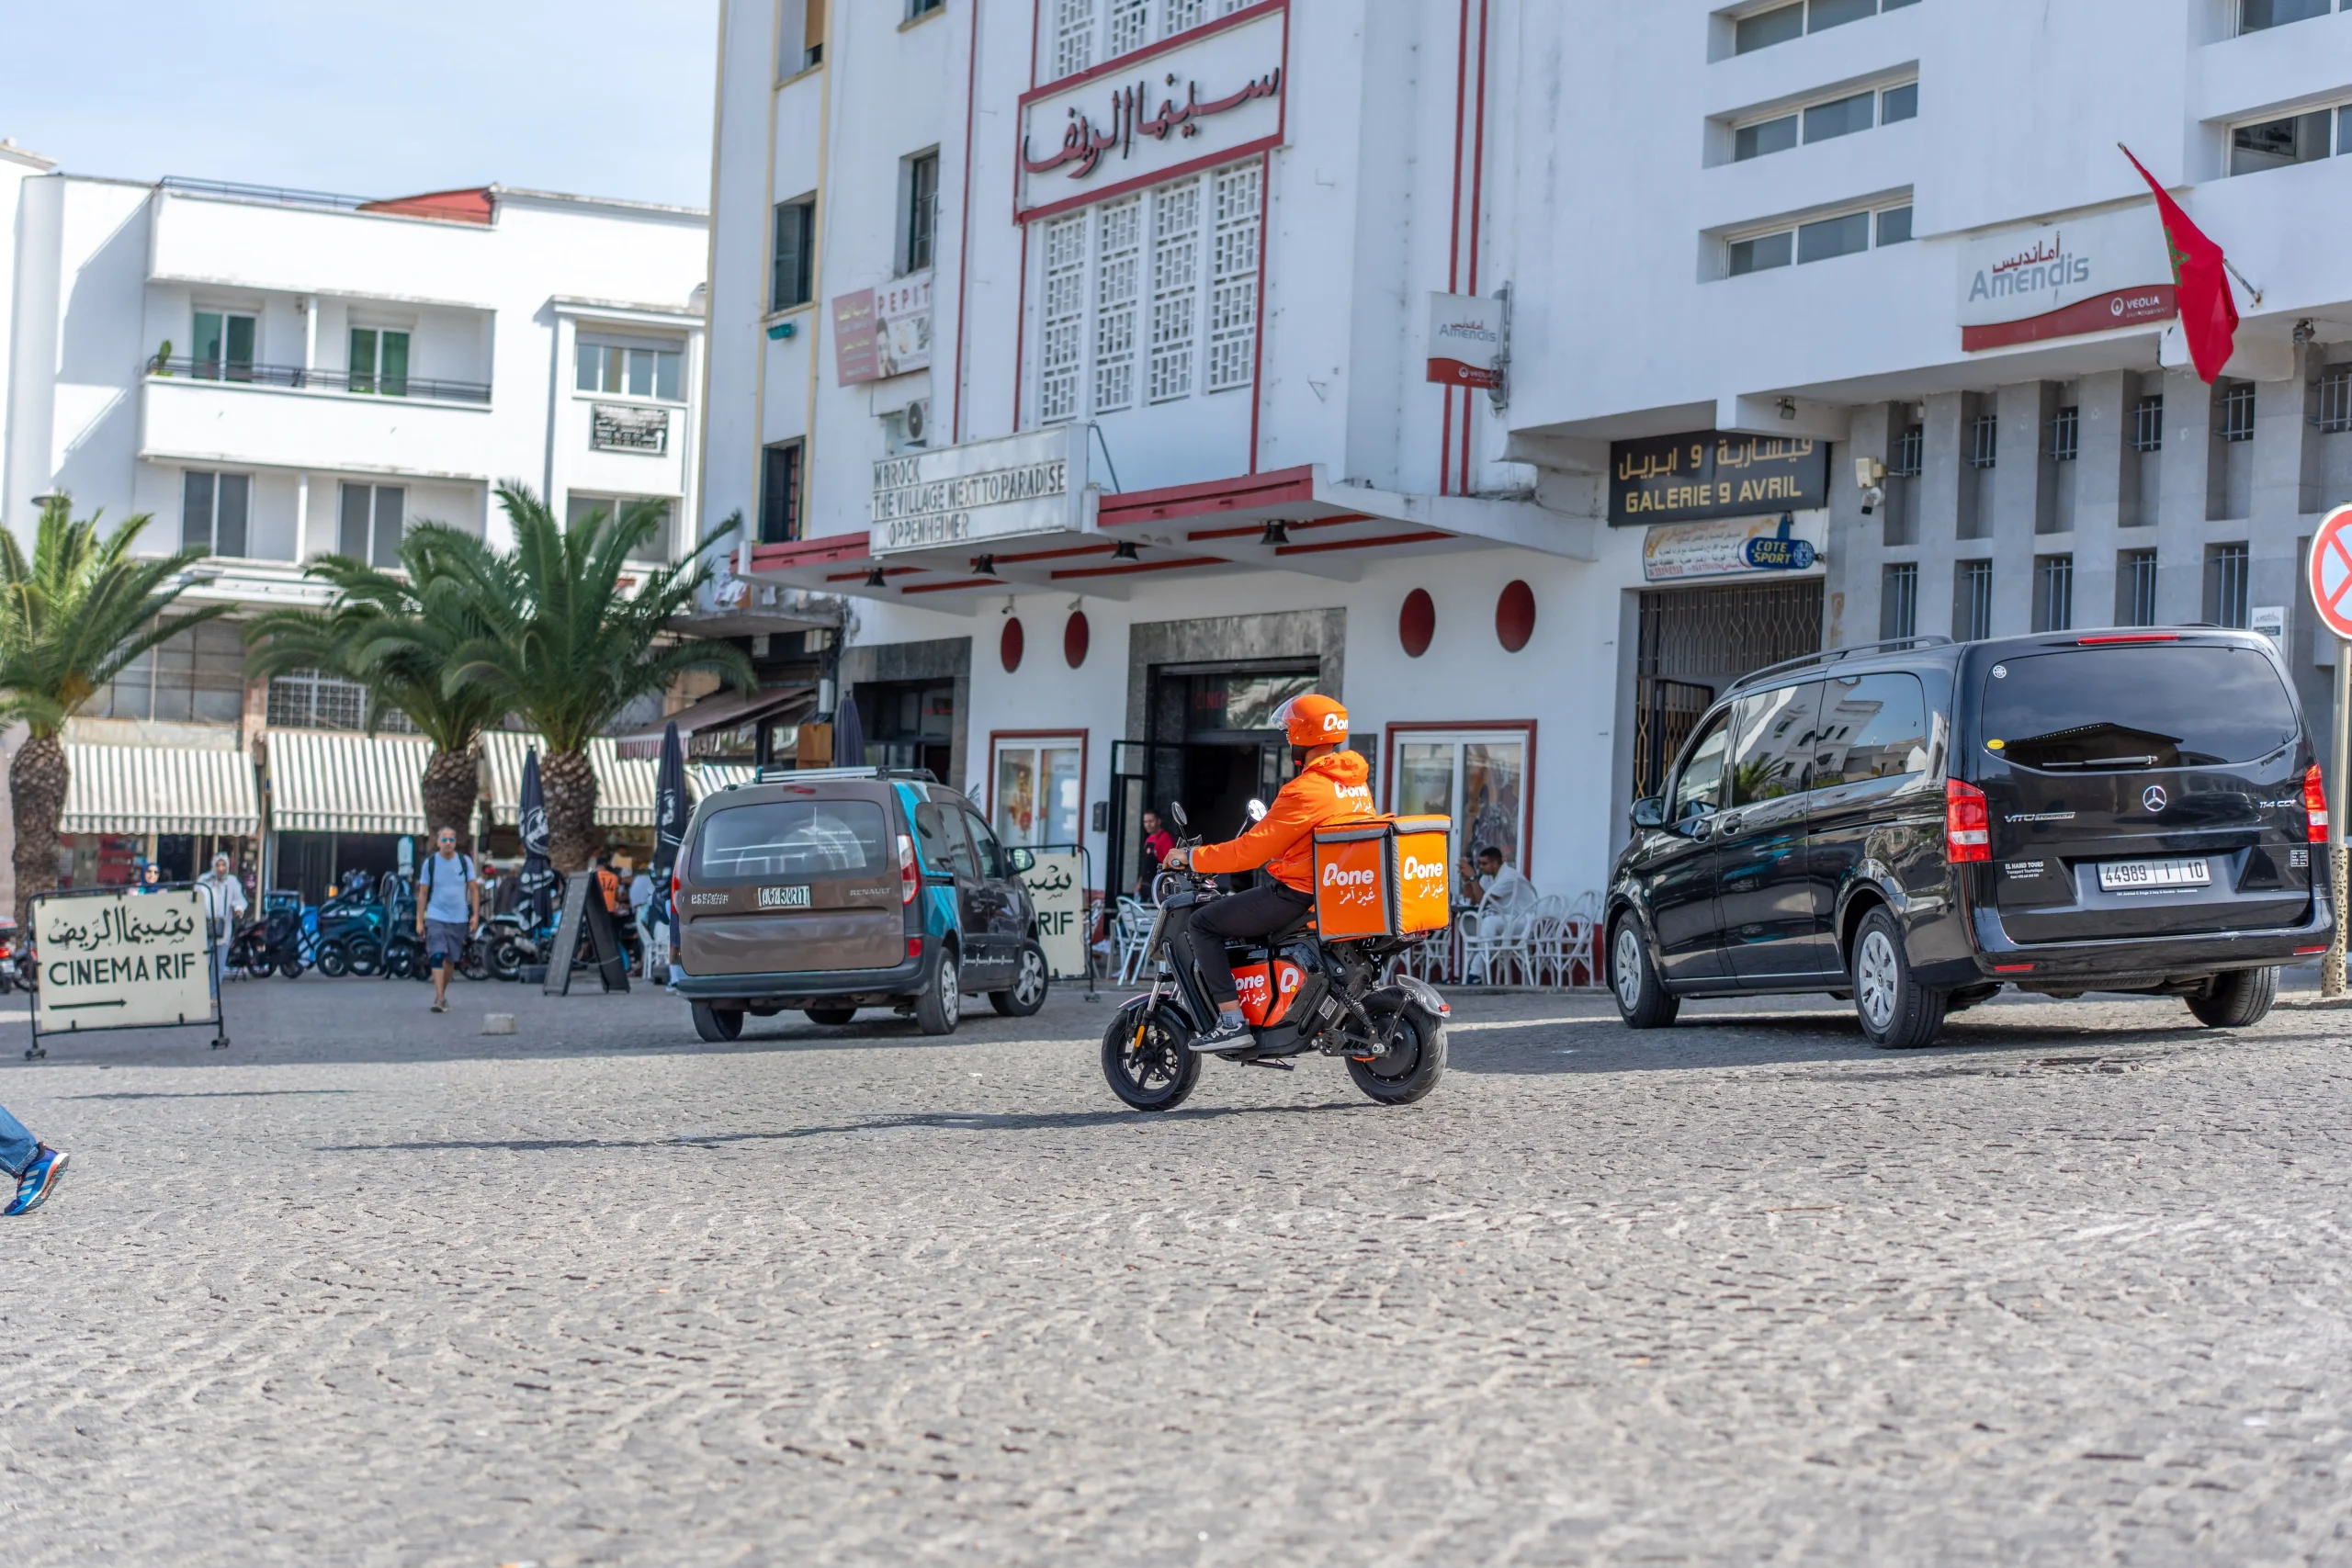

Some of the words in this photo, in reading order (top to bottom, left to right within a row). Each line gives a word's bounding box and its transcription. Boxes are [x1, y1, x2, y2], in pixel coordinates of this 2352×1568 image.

[1968, 253, 2090, 302] Amendis
[2126, 295, 2160, 310] VEOLIA
[1439, 323, 1497, 342] Amendis
[874, 458, 920, 490] MAROCK
[874, 492, 893, 520] THE
[897, 484, 944, 515] VILLAGE
[948, 479, 979, 509] NEXT
[983, 476, 999, 501] TO
[1001, 464, 1066, 500] PARADISE
[1625, 485, 1712, 513] GALERIE
[1718, 482, 1731, 503] 9
[1738, 476, 1803, 502] AVRIL
[888, 513, 969, 547] OPPENHEIMER
[1756, 540, 1788, 553] COTE
[1753, 552, 1793, 565] SPORT
[1323, 713, 1349, 731] Don
[2004, 814, 2035, 823] VITO
[1322, 863, 1374, 886] Done
[1404, 856, 1443, 880] Done
[2105, 864, 2148, 883] 44989
[2188, 862, 2204, 879] 10
[601, 877, 615, 893] 14
[850, 887, 891, 897] RENAULT
[1038, 911, 1074, 936] RIF
[49, 955, 151, 987] CINEMA
[155, 953, 196, 980] RIF
[1232, 973, 1265, 991] one
